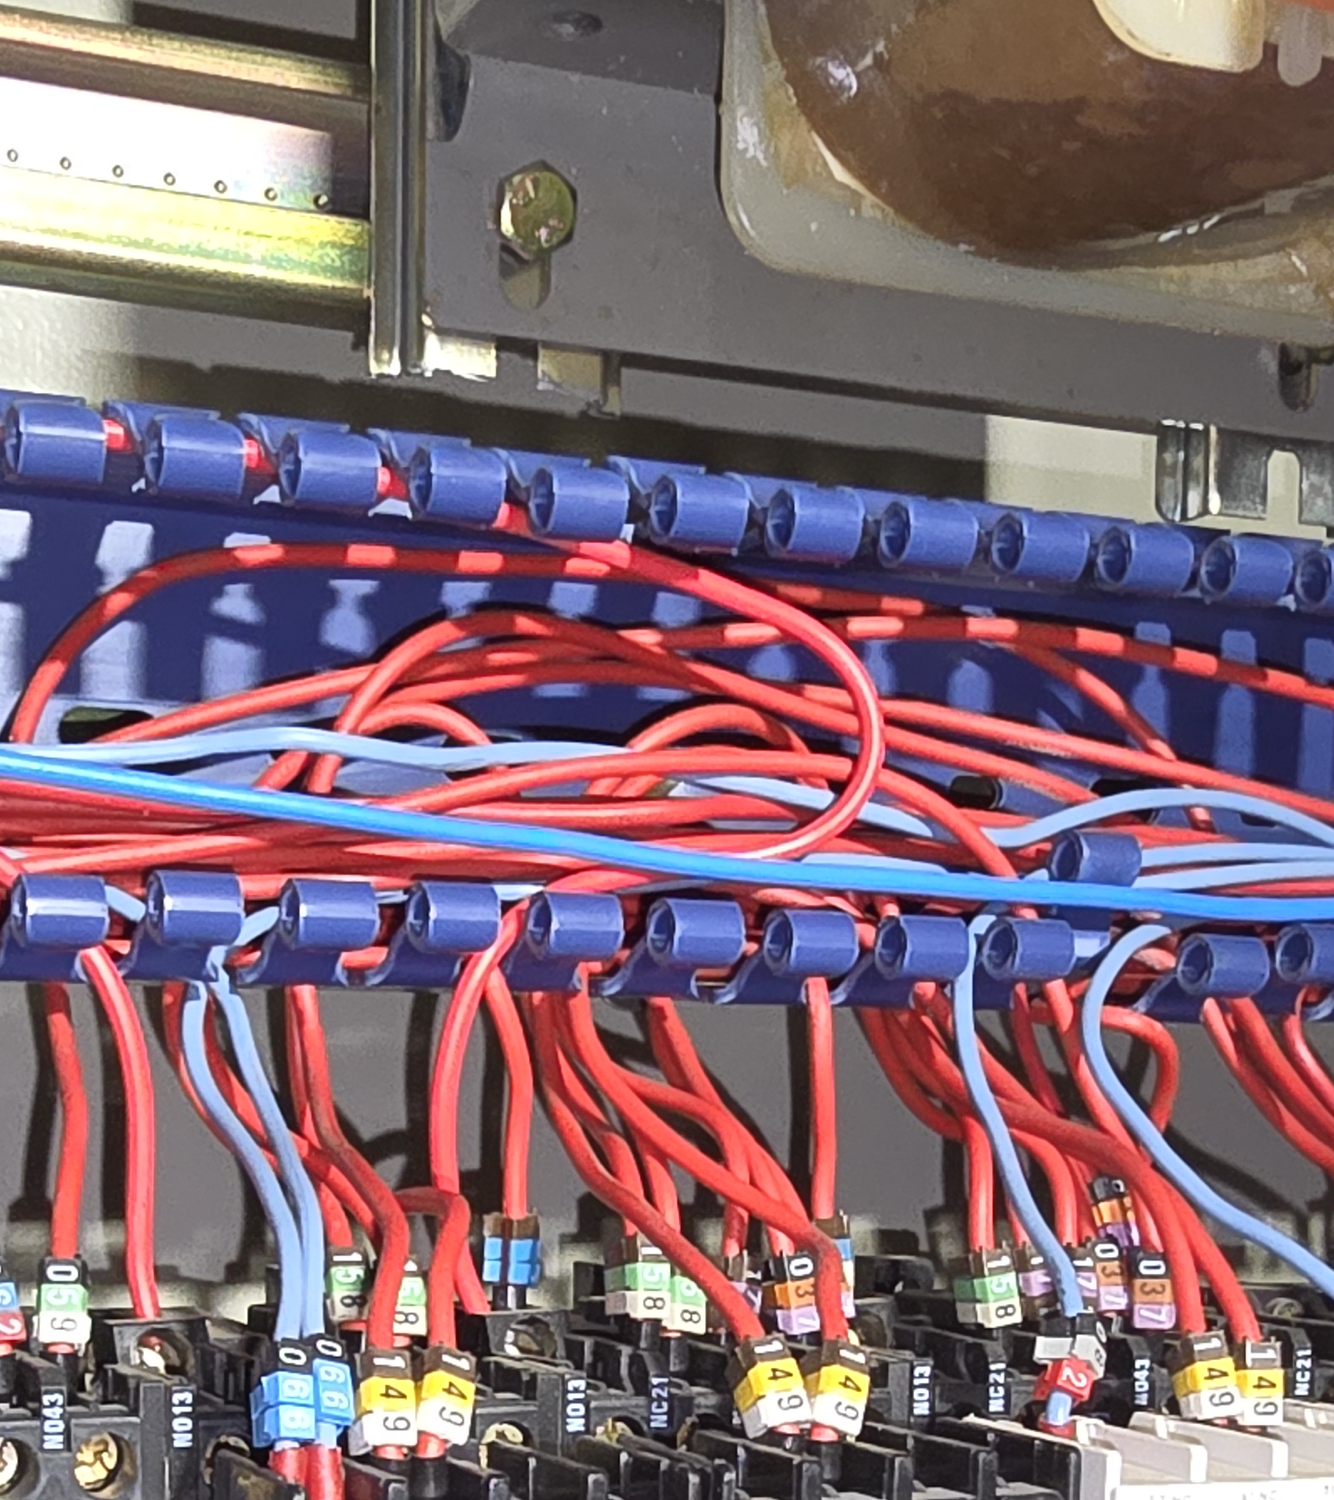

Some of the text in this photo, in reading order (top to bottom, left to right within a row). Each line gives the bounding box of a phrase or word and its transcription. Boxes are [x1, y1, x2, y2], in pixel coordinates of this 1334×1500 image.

[912, 1364, 933, 1415] NO13
[988, 1362, 1007, 1413] NC21
[1294, 1347, 1313, 1396] NC21
[41, 1390, 66, 1451] NO43
[171, 1389, 194, 1449] NO13
[565, 1378, 587, 1433] NO13
[650, 1376, 670, 1429] NC21
